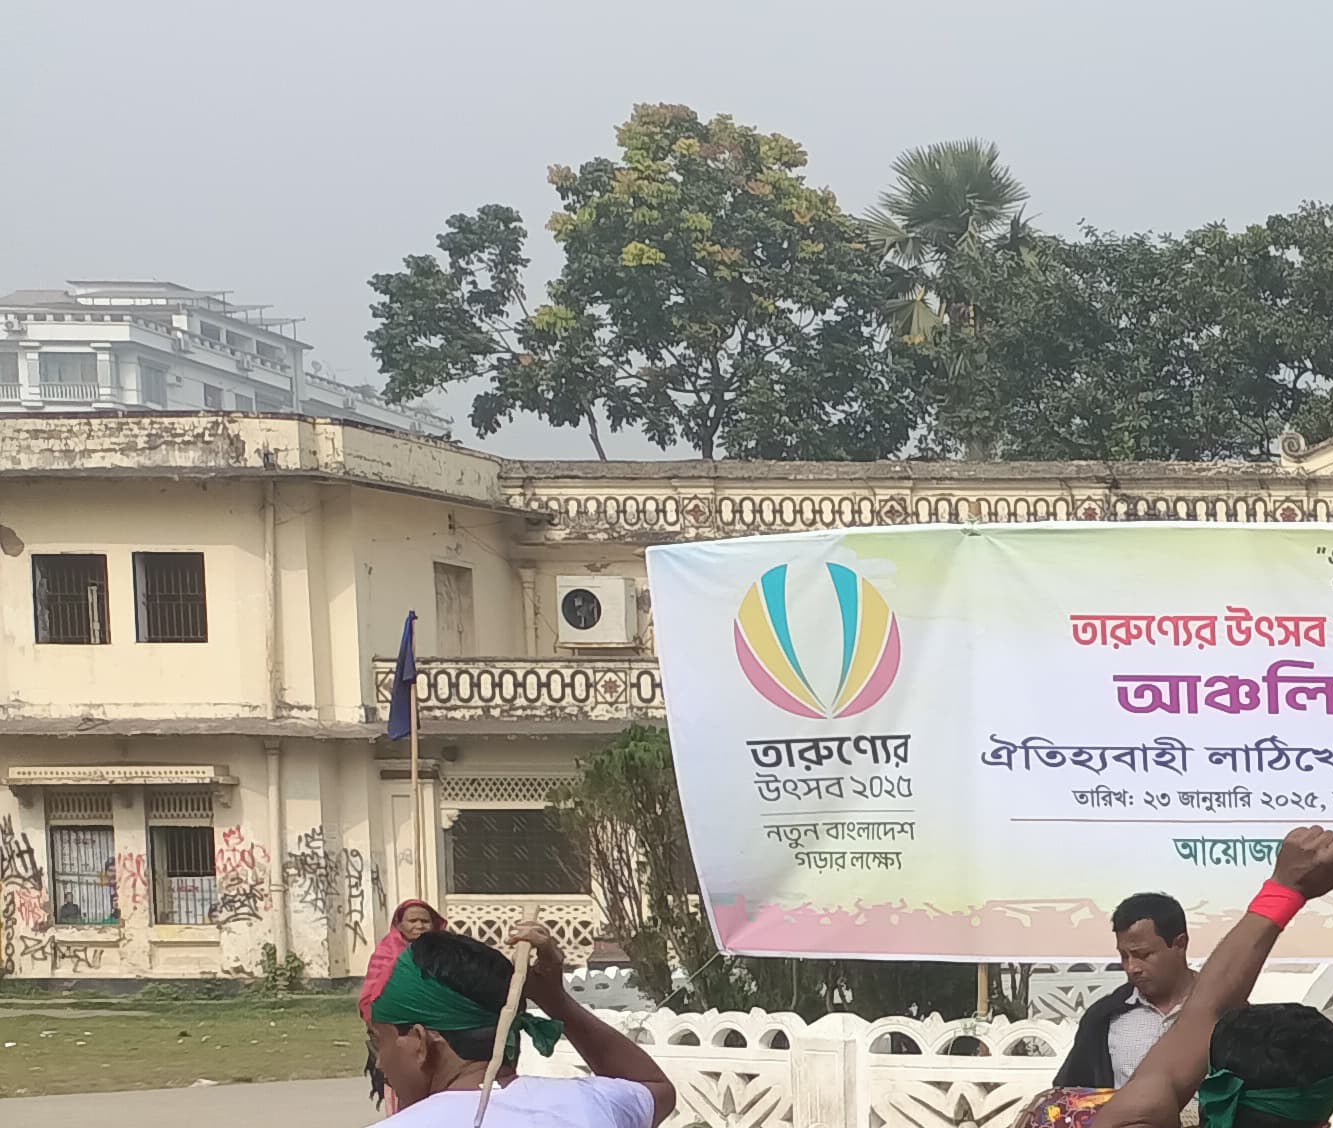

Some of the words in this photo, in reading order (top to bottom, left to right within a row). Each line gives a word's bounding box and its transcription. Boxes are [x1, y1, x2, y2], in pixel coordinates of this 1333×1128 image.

[1069, 614, 1218, 650] তারুণ্যের
[1223, 605, 1327, 648] উৎসব
[746, 734, 911, 772] তারুণ্যের
[981, 733, 1195, 776] ঐতিহ্যবাহী
[753, 772, 845, 802] উৎসব
[849, 775, 913, 800] ২০২৫
[1071, 784, 1134, 809] তারিখ:
[1143, 789, 1171, 810] ২৩
[1176, 785, 1253, 813] জানুয়ারি
[1260, 790, 1327, 812] ২০২৫,
[763, 822, 820, 849] নতুন
[821, 821, 916, 841] বাংলাদেশ
[794, 851, 848, 874] গড়ার
[849, 851, 903, 871] লক্ষ্যে
